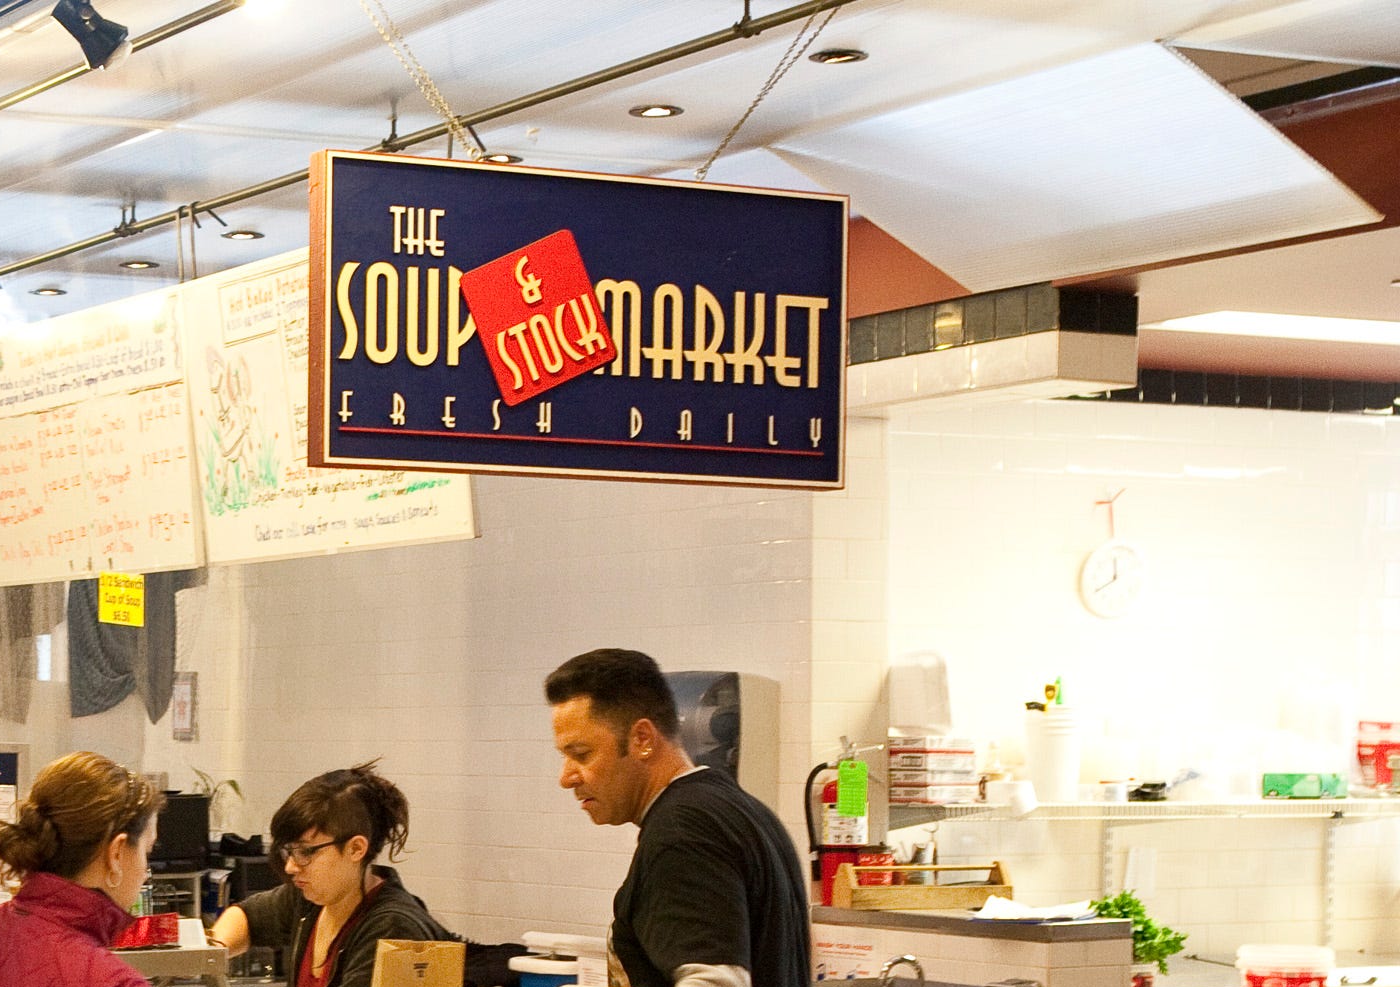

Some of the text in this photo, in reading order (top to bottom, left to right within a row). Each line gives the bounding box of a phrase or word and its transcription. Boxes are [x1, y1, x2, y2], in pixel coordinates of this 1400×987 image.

[389, 205, 446, 257] THE
[514, 255, 543, 305] &
[337, 260, 478, 367] SOUP
[595, 278, 830, 389] MARKET
[496, 292, 608, 390] STOCK
[338, 390, 823, 448] FRESH DAILY
